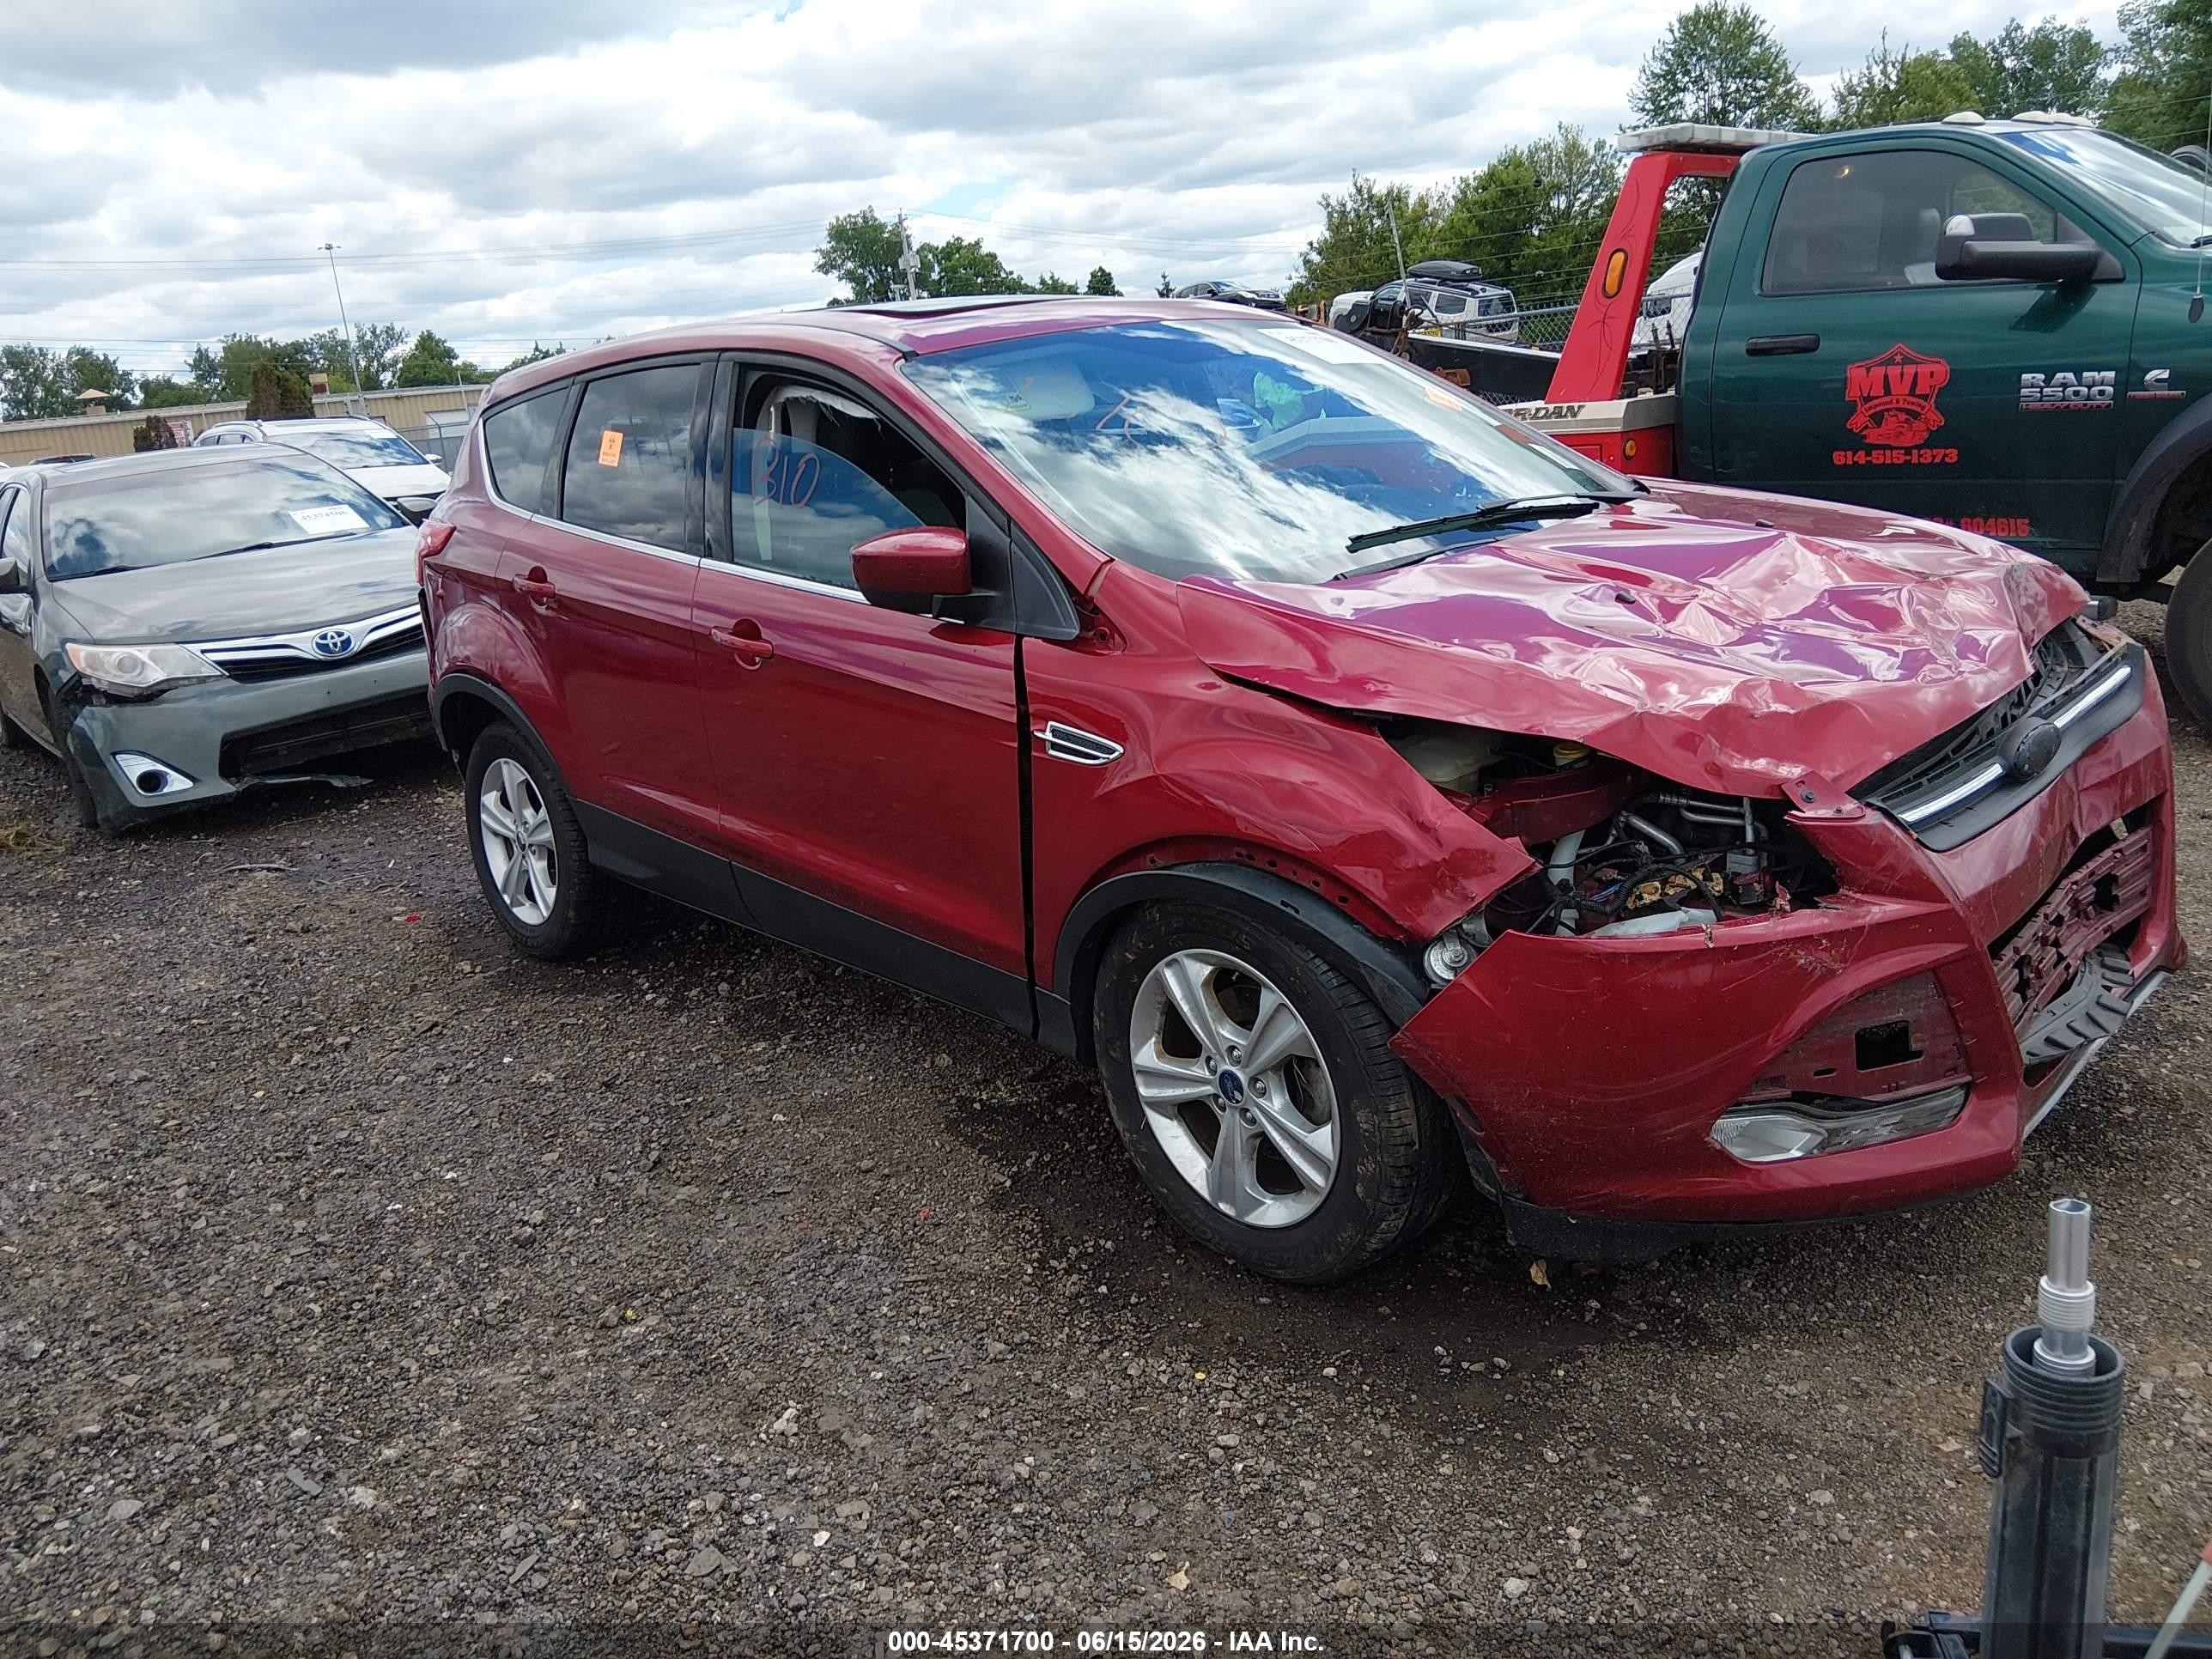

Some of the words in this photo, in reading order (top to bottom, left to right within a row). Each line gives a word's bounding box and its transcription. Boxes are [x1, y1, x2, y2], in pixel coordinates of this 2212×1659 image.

[1847, 362, 1948, 398] MVP
[2021, 370, 2117, 386] RAM
[2020, 386, 2114, 402] 5500
[1832, 448, 1959, 465] 614-515-1373
